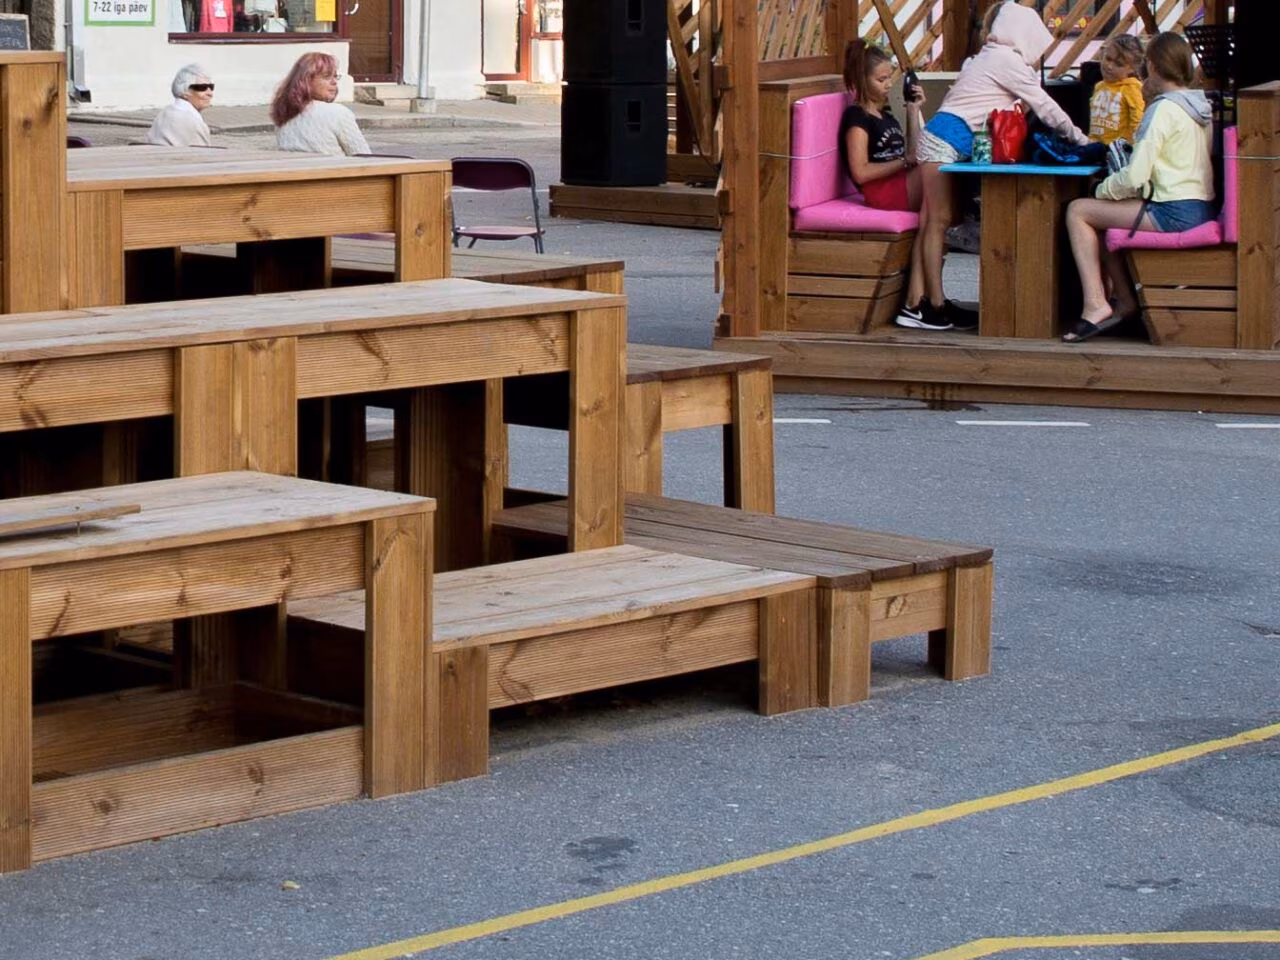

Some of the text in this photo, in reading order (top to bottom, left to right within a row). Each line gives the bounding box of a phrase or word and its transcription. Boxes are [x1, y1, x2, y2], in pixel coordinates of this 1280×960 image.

[93, 0, 148, 15] 7-22 iga päev
